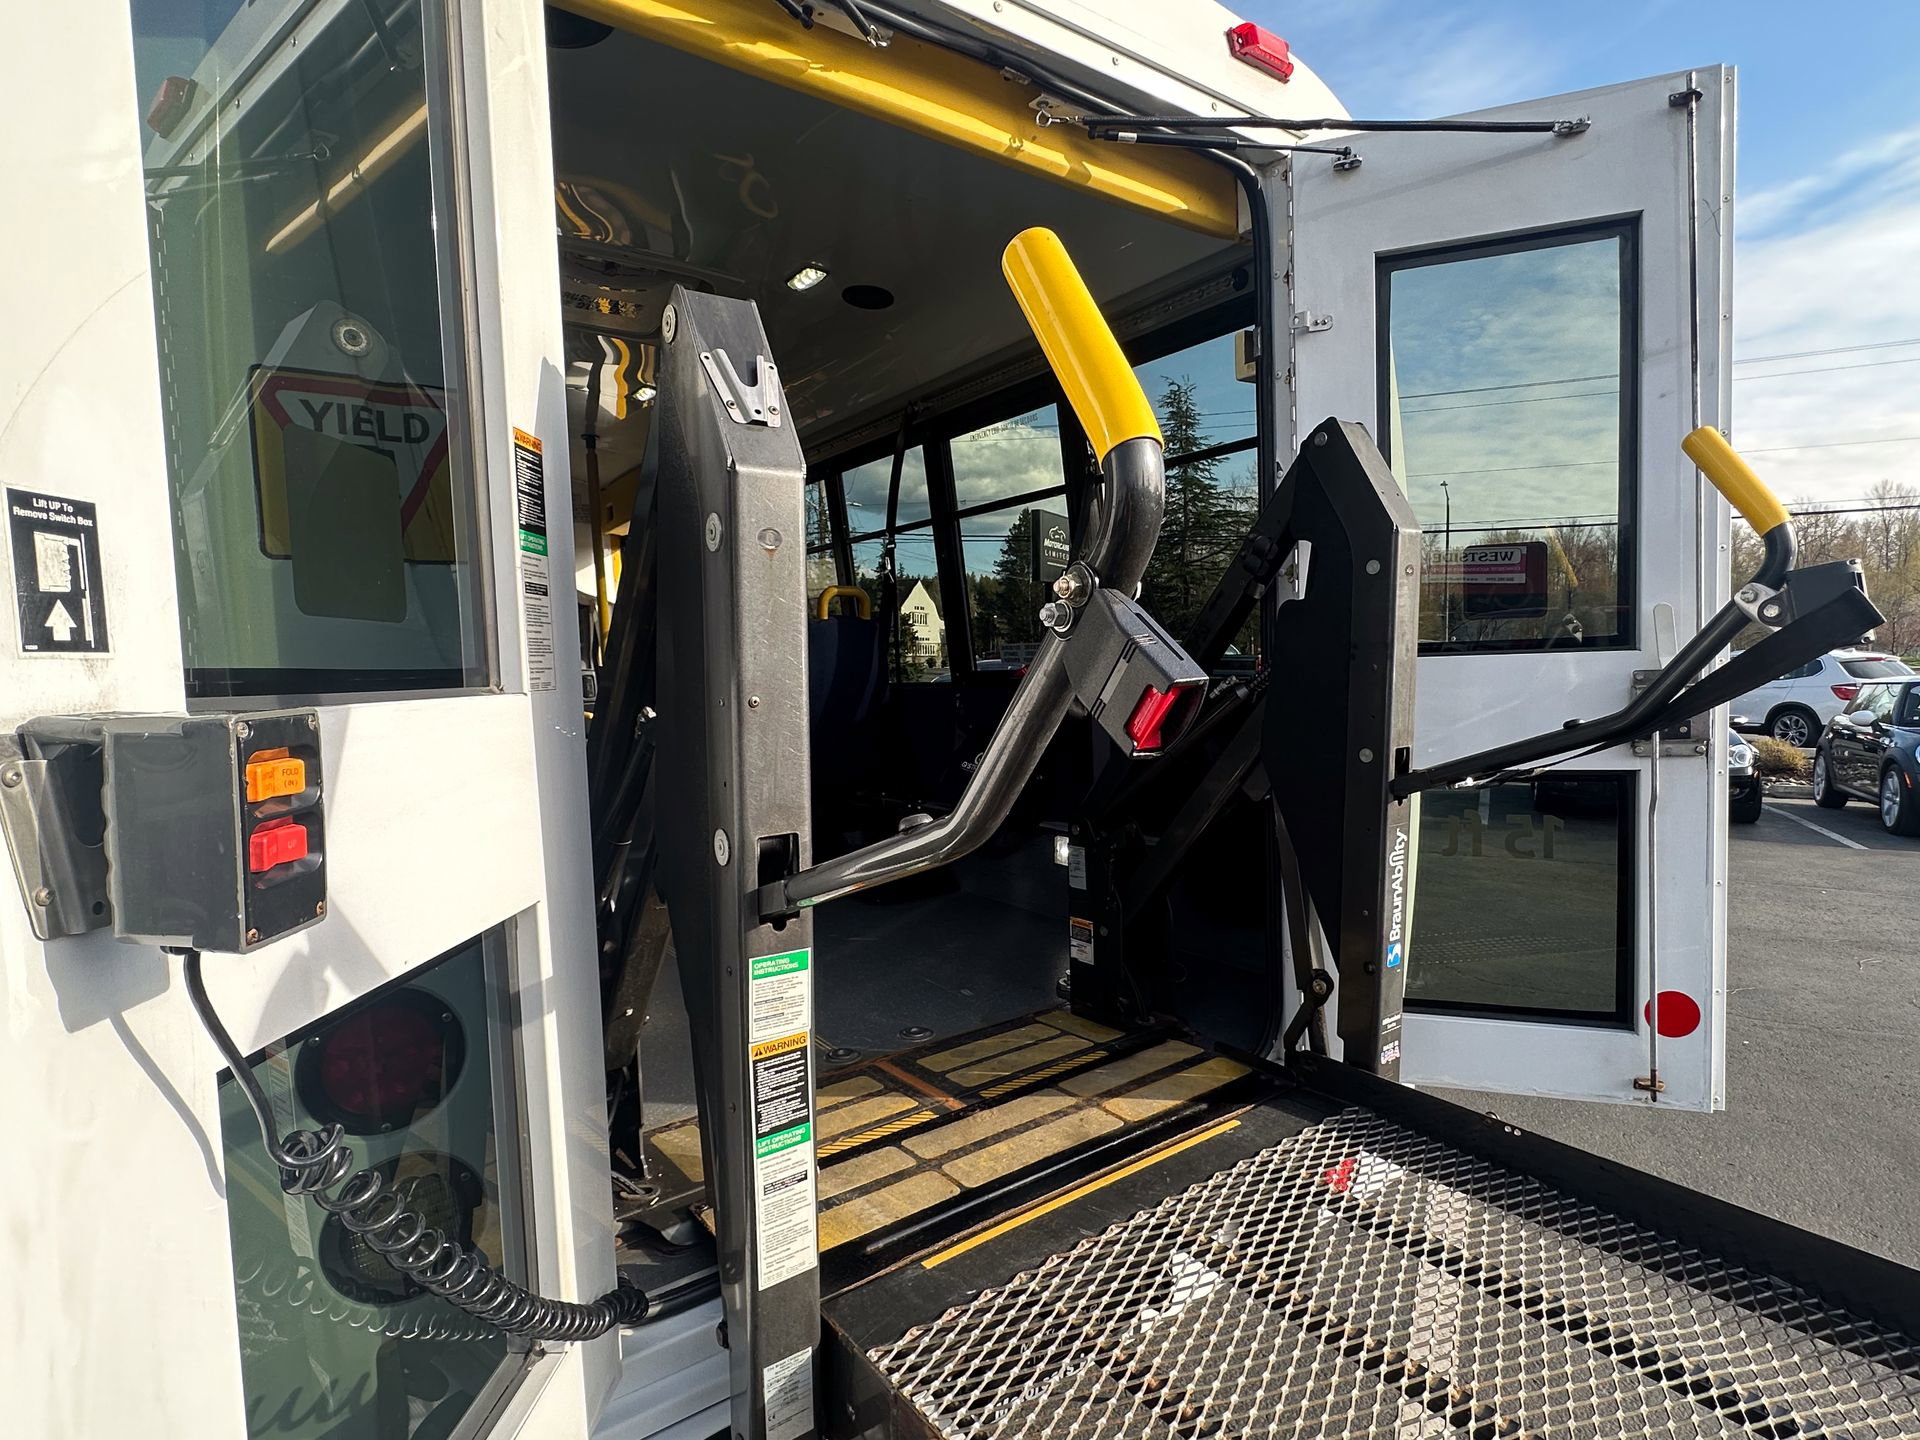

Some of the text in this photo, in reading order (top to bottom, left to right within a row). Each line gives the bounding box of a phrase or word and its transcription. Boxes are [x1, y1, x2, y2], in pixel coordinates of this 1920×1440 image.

[298, 398, 429, 444] YIELD
[33, 498, 73, 512] Lift UP To
[12, 506, 93, 527] Remove Switch Box
[281, 767, 299, 776] FOLD
[1390, 828, 1407, 941] BraunAbility
[753, 958, 790, 969] OPERATING
[753, 962, 799, 976] INSTRUCTIONS
[763, 1036, 806, 1054] WARNING
[757, 1127, 806, 1148] LIFT OPERATING
[757, 1135, 802, 1155] INSTRUCTIONS
